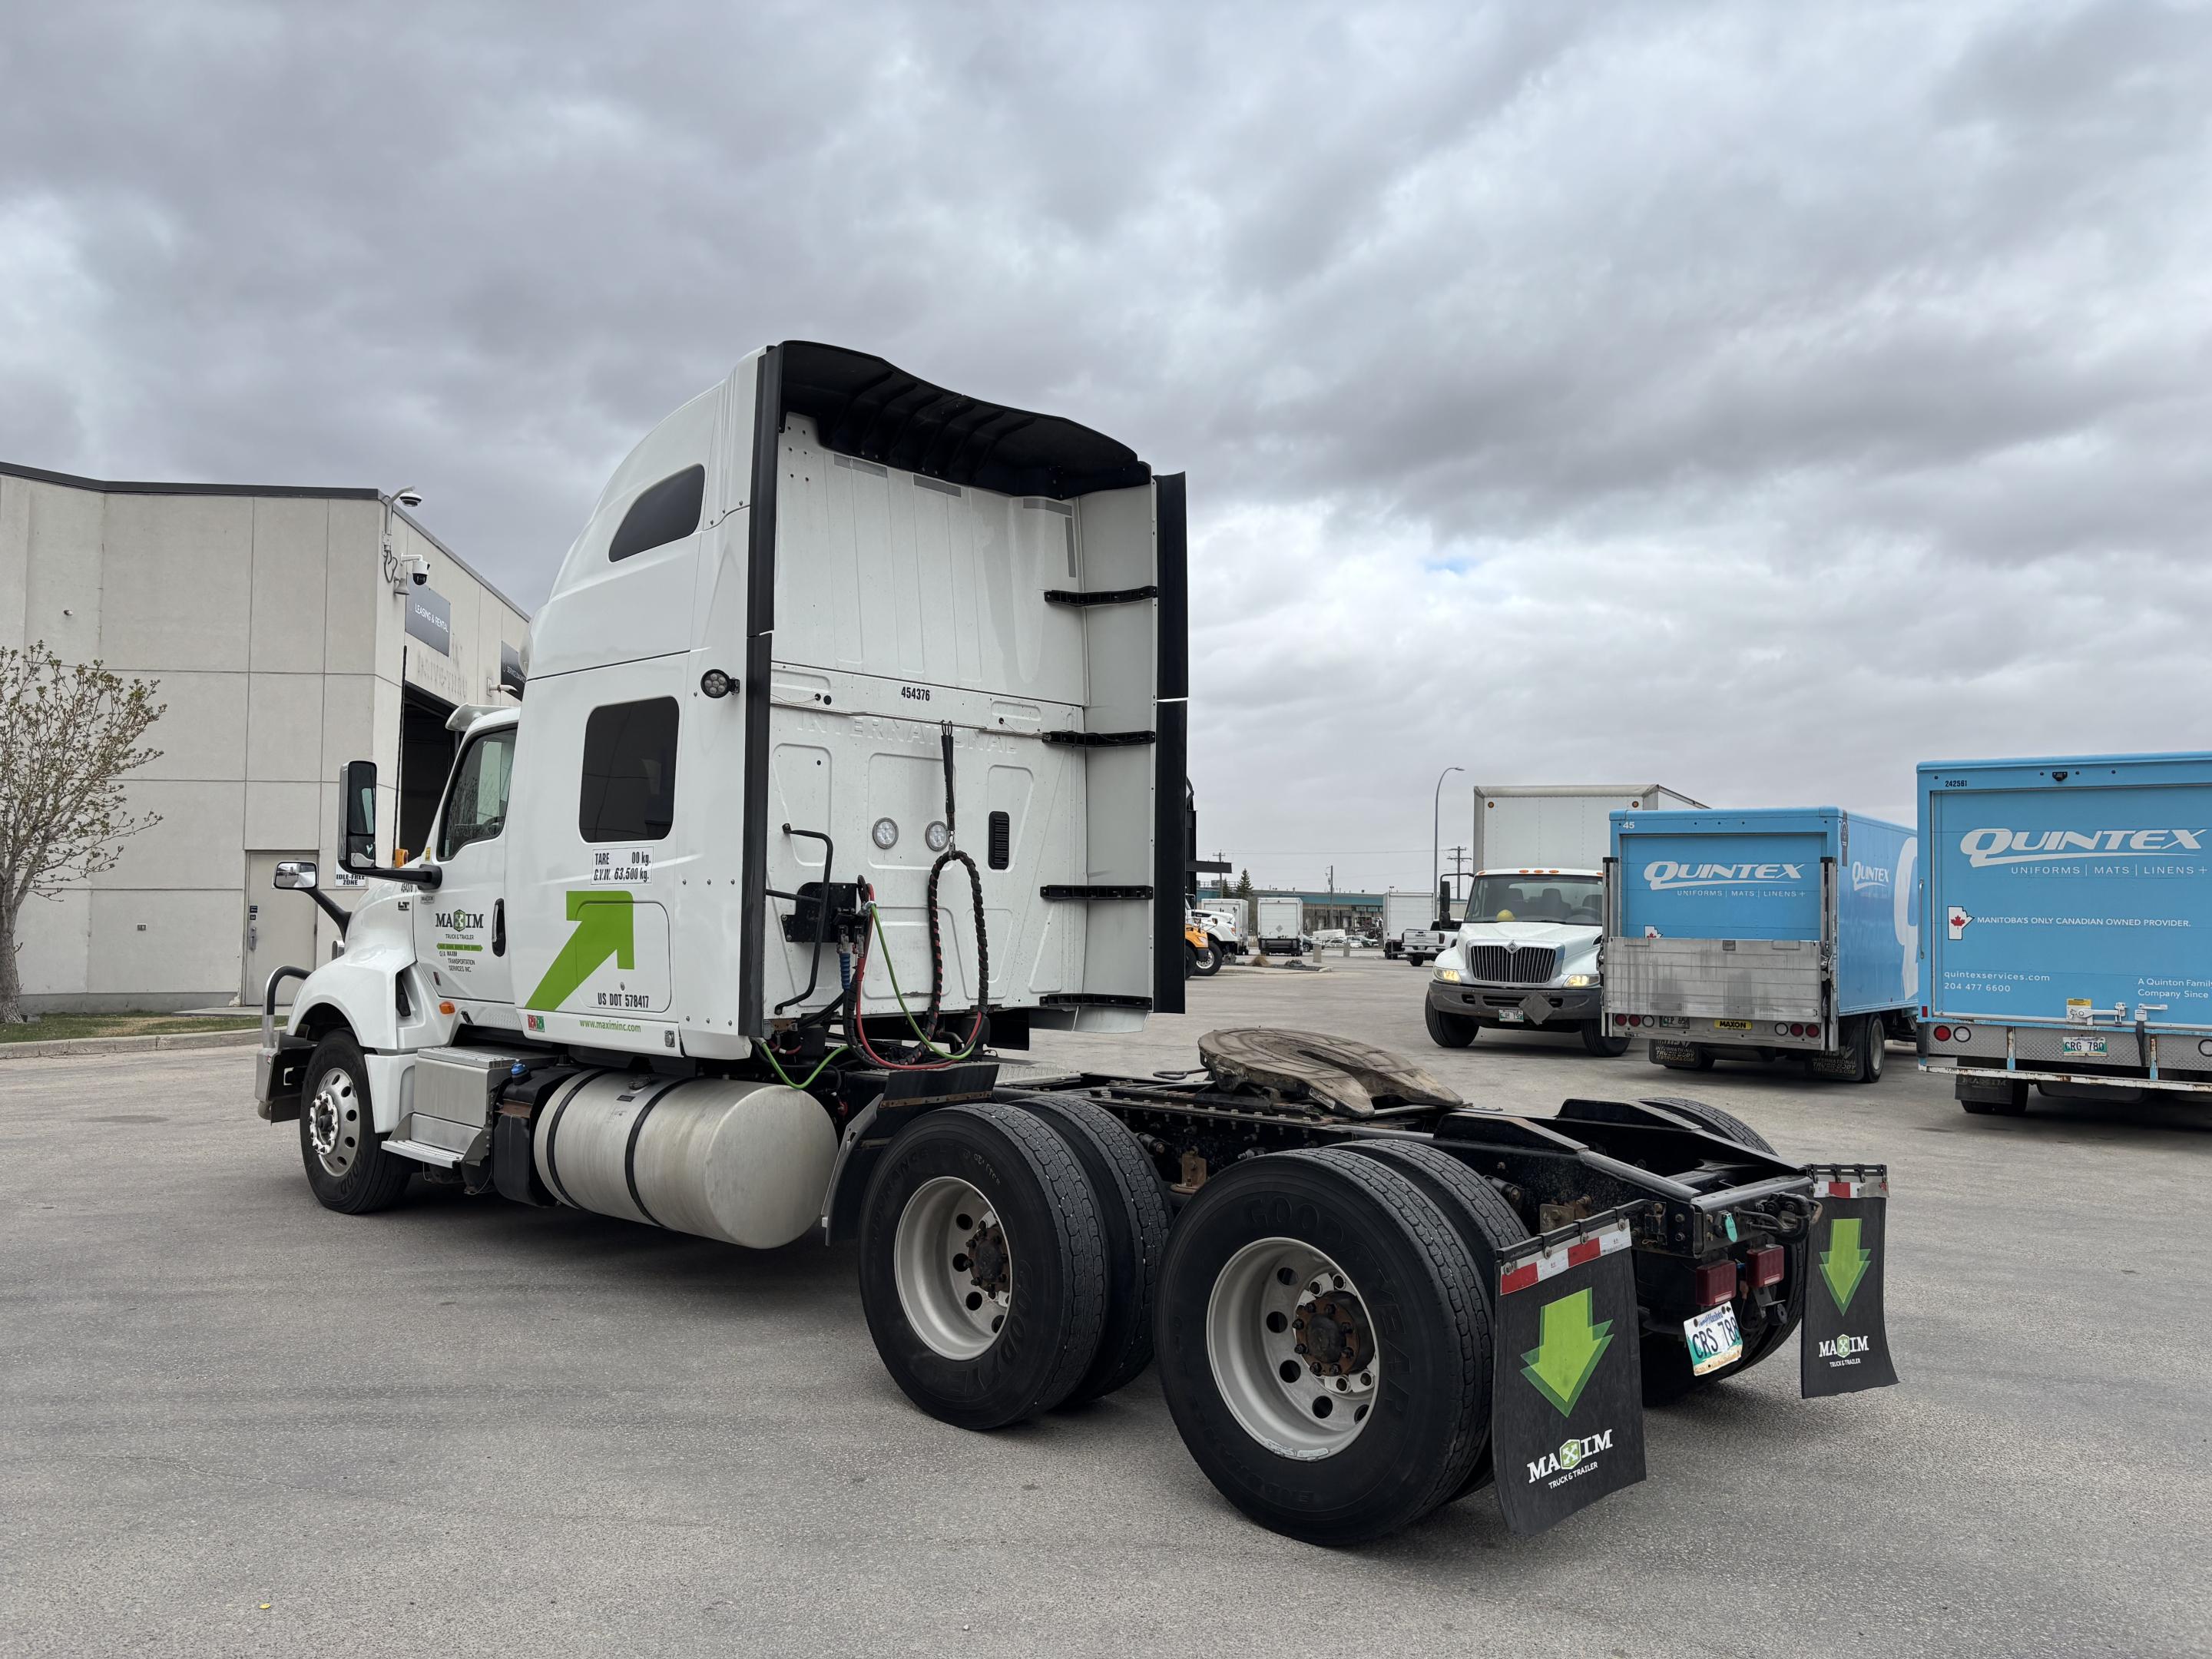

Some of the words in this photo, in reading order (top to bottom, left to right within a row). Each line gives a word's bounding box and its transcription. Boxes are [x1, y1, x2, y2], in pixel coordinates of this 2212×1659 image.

[415, 603, 431, 621] LEASING
[432, 614, 435, 623] &
[435, 617, 449, 633] RENTAL
[901, 686, 930, 701] 454376
[1960, 828, 2207, 868] QUINTEX
[594, 853, 610, 865] TARE
[631, 851, 640, 864] 00
[641, 851, 651, 866] kg.
[594, 869, 611, 881] G.V.W.
[614, 867, 638, 881] 63,500
[640, 867, 649, 882] kg.
[1644, 860, 1805, 890] QUINTEX
[1852, 861, 1889, 891] QUINTEX
[2011, 866, 2081, 874] UNIFORMS
[2094, 866, 2130, 874] MATS
[435, 910, 484, 931] MAXIM
[2055, 917, 2103, 926] CANADIAN
[1944, 972, 2050, 982] quintexservices.com
[2146, 978, 2184, 987] Quinton
[1985, 984, 2011, 992] 6600
[2137, 988, 2181, 999] Company
[2184, 990, 2209, 998] Since
[598, 992, 607, 1005] US
[609, 993, 622, 1006] DOT
[624, 994, 649, 1008] 578417
[579, 1019, 641, 1033] www.maximinc.com
[1720, 1020, 1747, 1028] MAXON
[2065, 1041, 2082, 1051] CRG
[2088, 1041, 2104, 1051] 780
[1692, 1327, 1719, 1359] CRS
[1819, 1335, 1869, 1358] MAXIM
[1527, 1429, 1613, 1484] MAXIM
[1548, 1474, 1568, 1489] TRUCK
[1573, 1462, 1598, 1478] TRAILER
